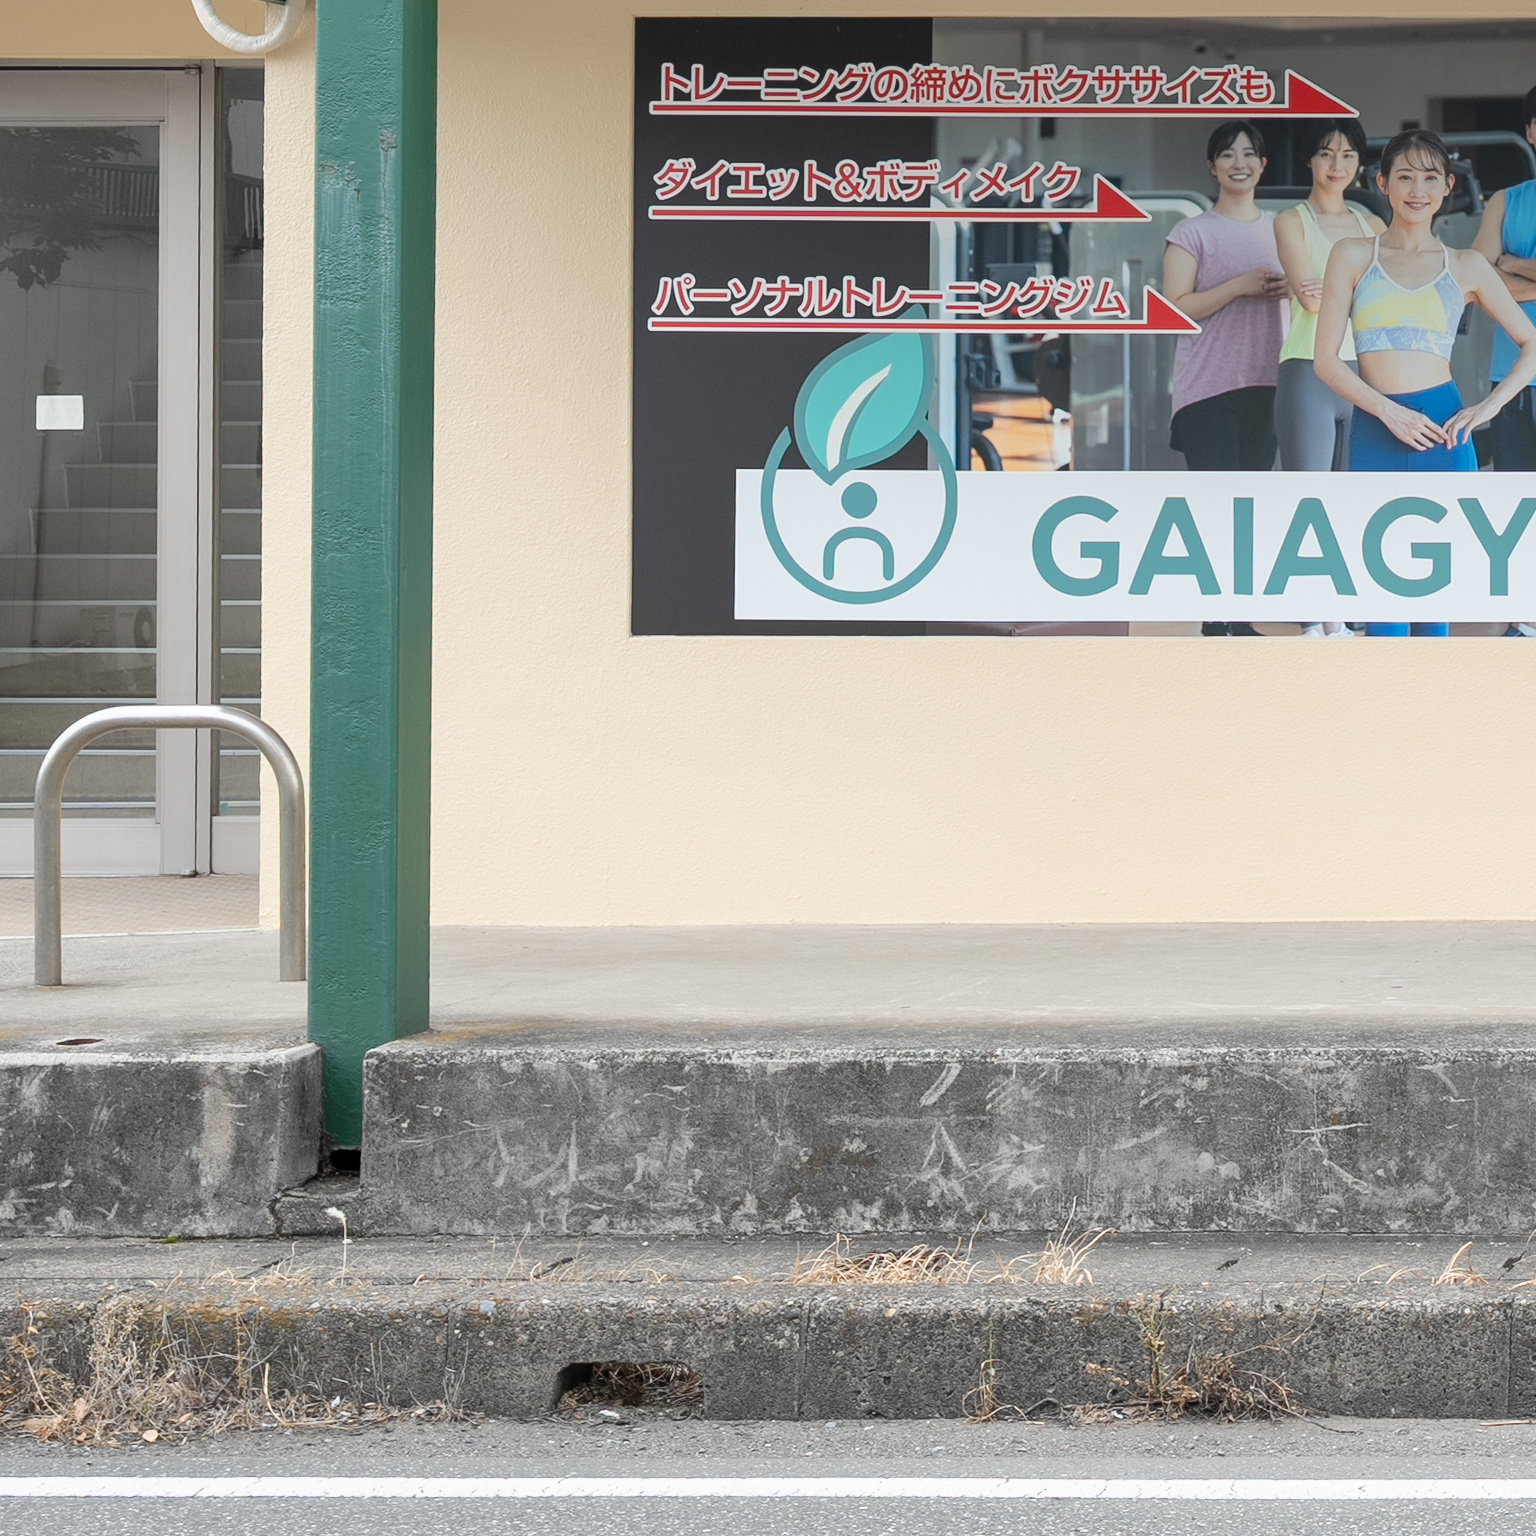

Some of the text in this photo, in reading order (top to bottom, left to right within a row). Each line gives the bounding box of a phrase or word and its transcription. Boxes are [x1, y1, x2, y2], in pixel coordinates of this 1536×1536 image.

[659, 64, 1273, 104] トレーニングの締めにボクササイズも
[654, 161, 1082, 201] ダイエット&ボディメイク
[652, 276, 1129, 318] パーソナルトレーニングジム
